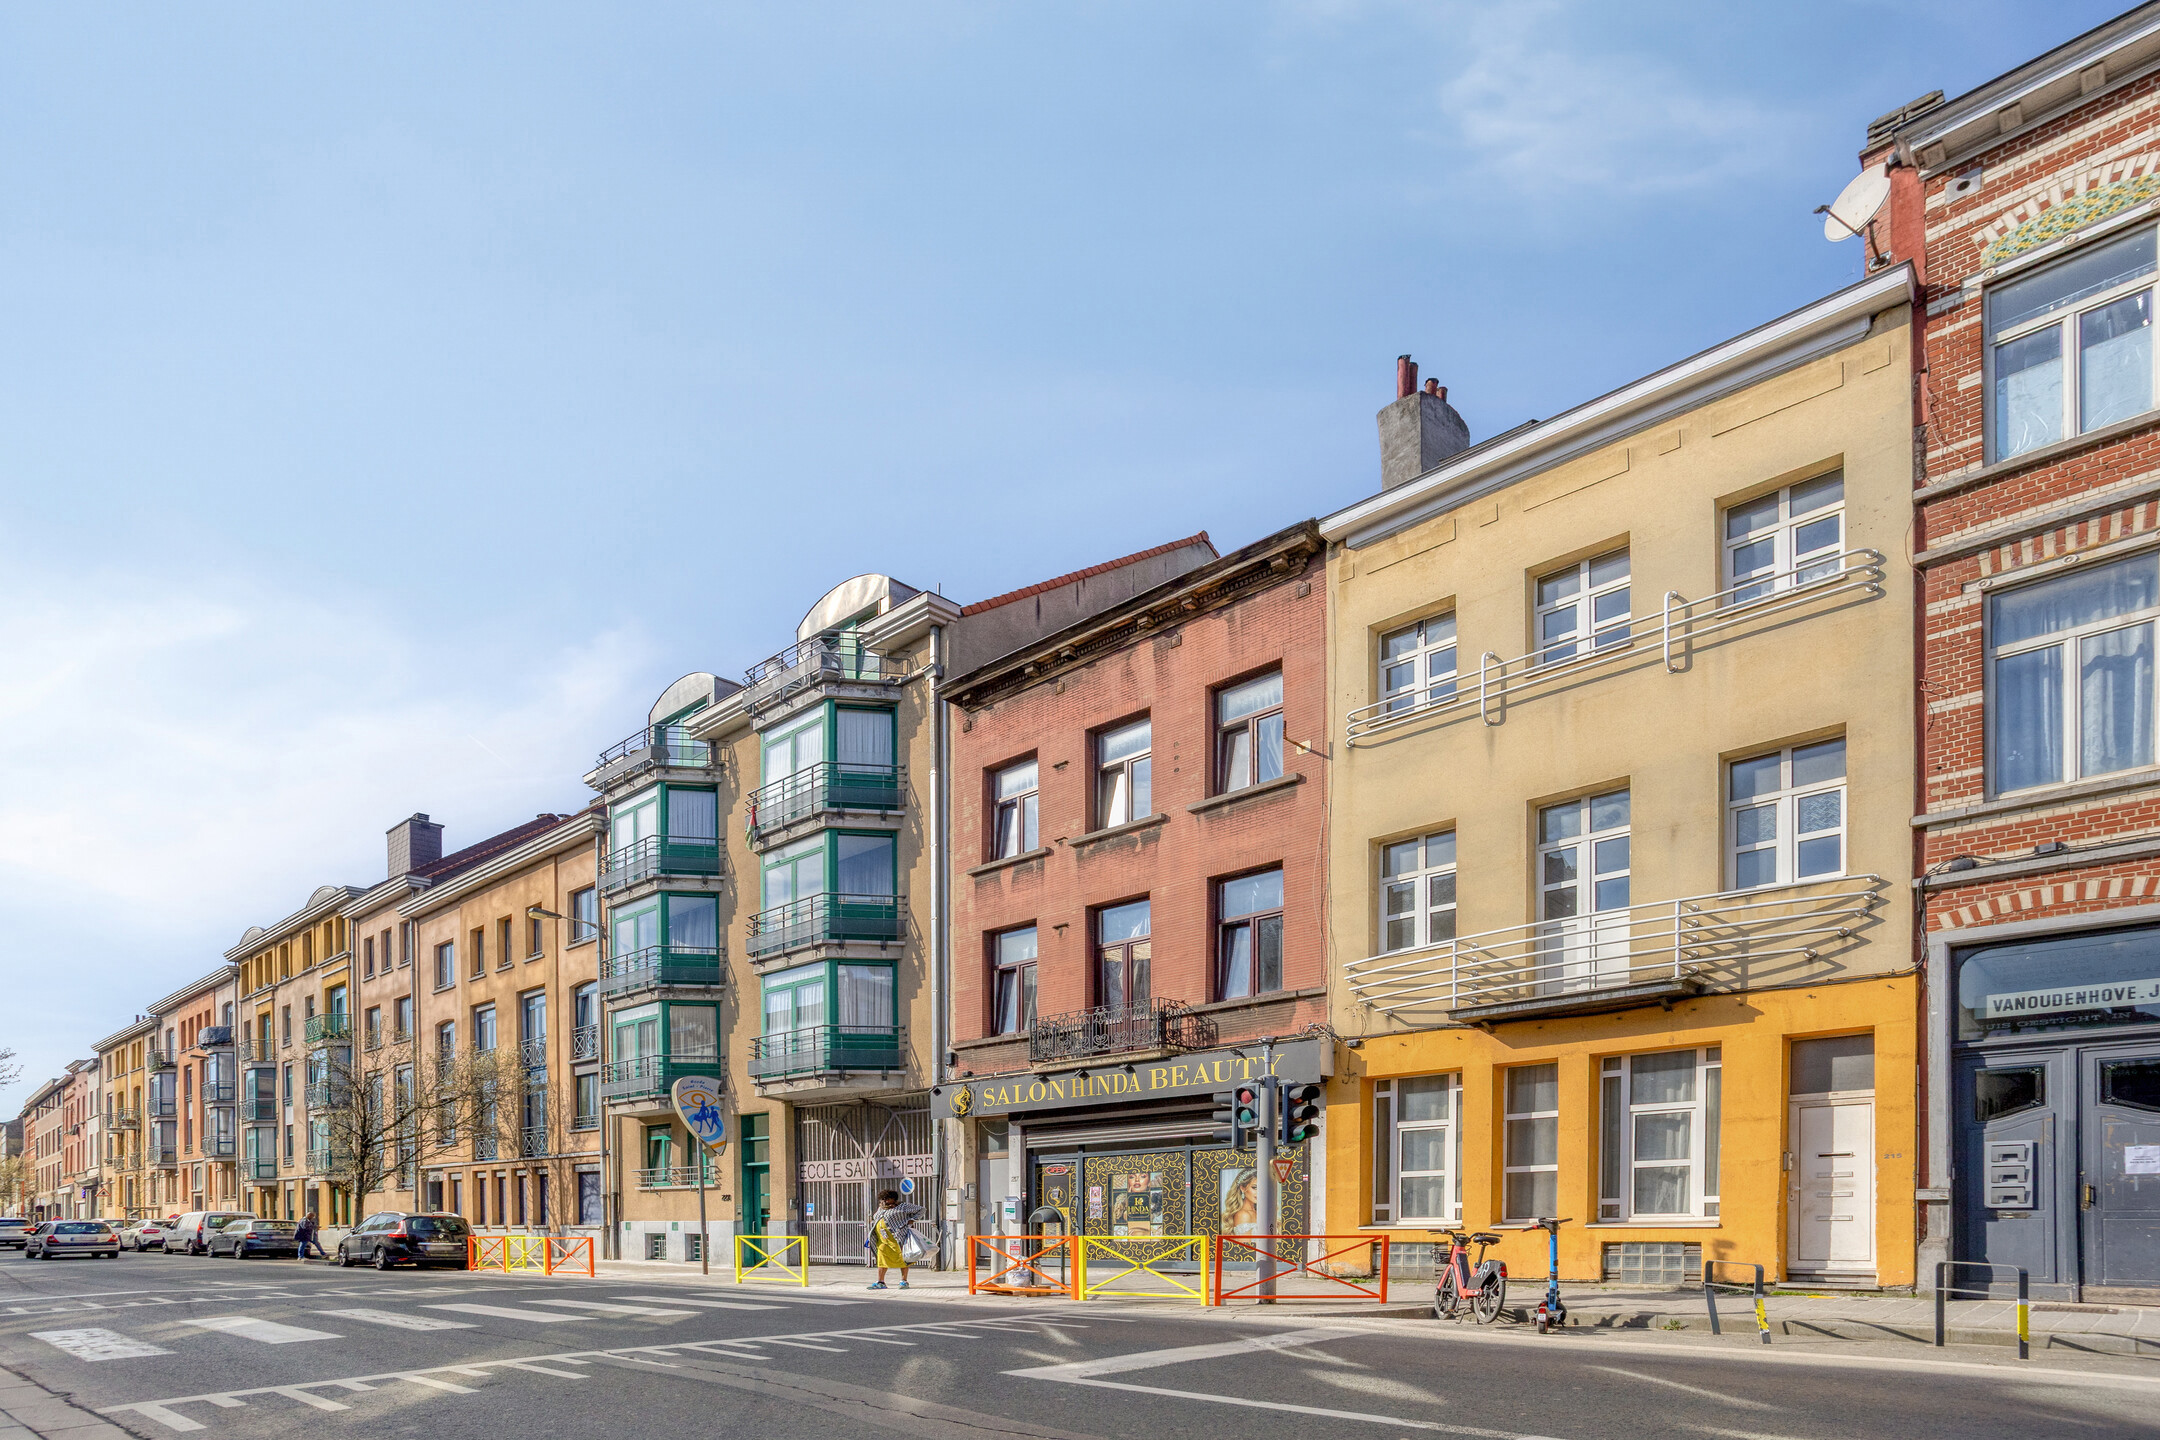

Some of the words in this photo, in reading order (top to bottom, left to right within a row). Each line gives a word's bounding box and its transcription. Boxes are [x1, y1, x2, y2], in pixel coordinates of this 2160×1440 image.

[983, 1080, 1067, 1107] SALON
[1071, 1073, 1143, 1099] HINDA
[1148, 1054, 1285, 1090] BEAUTY
[801, 1162, 841, 1180] ECOLE
[845, 1157, 934, 1178] SAINT-PIERR
